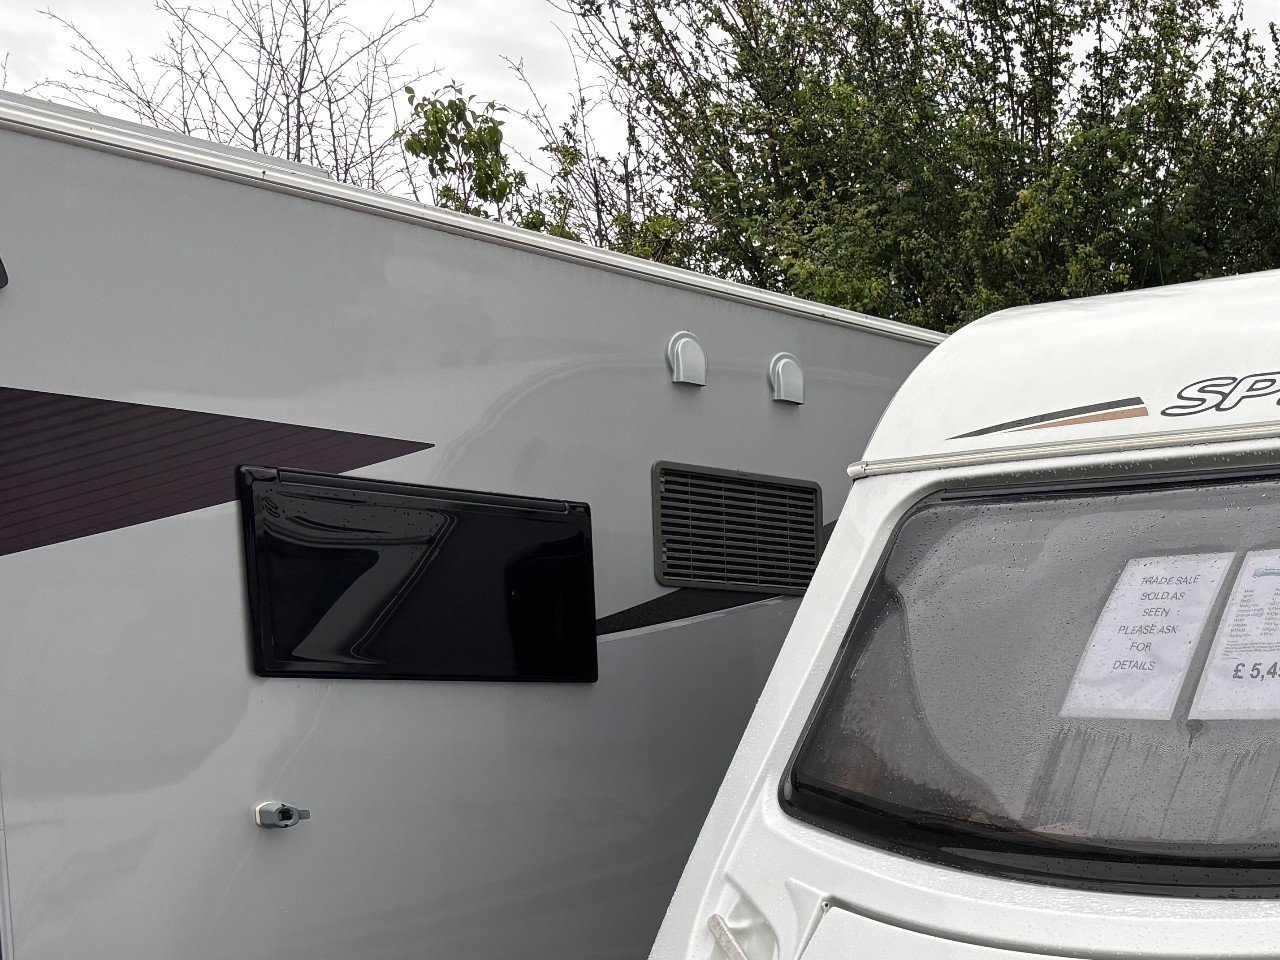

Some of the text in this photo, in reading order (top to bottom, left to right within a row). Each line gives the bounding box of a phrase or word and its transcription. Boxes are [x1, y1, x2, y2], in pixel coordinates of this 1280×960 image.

[1140, 574, 1201, 586] TRADE SALE
[1140, 591, 1186, 601] SOLD AS
[1141, 607, 1171, 617] SEEN
[1117, 624, 1179, 635] PLEASE ASK
[1129, 641, 1152, 652] FOR
[1112, 660, 1156, 671] DETAILS
